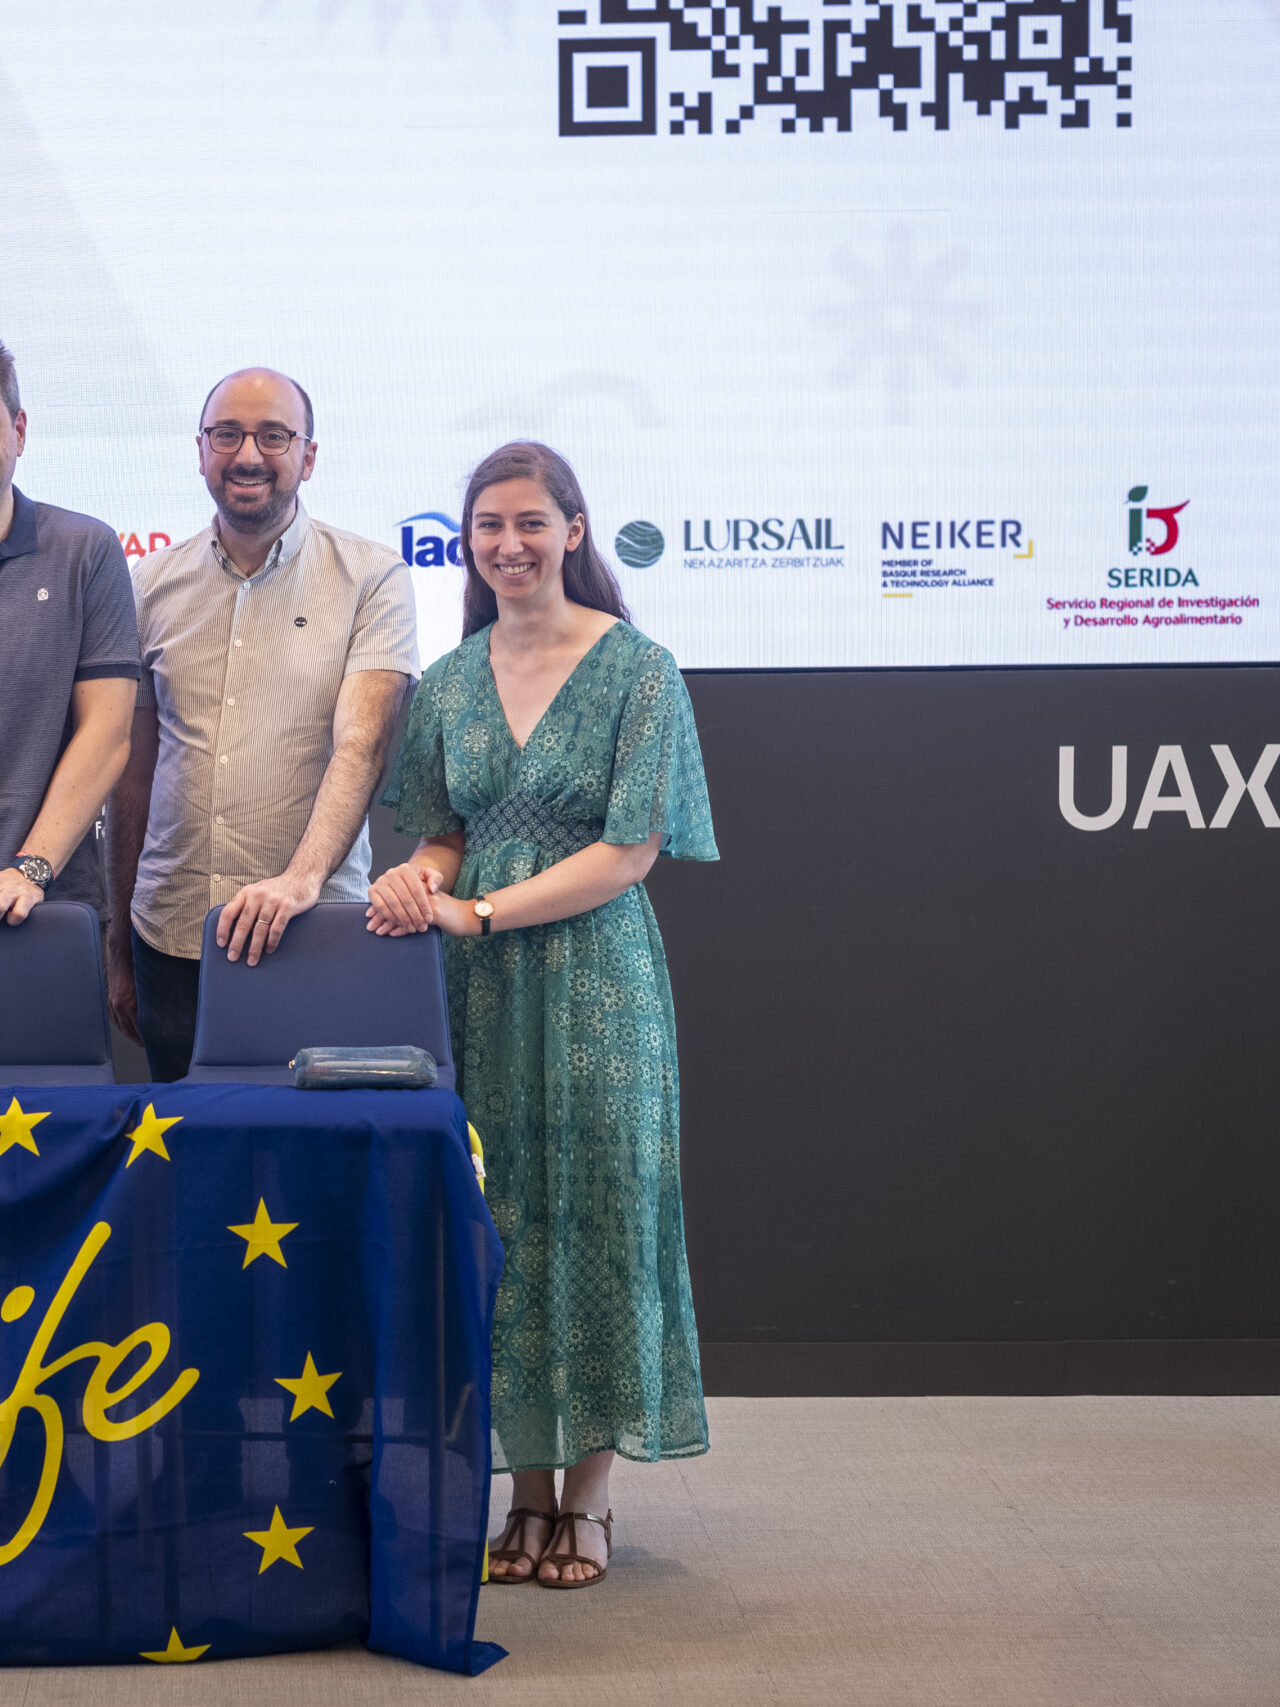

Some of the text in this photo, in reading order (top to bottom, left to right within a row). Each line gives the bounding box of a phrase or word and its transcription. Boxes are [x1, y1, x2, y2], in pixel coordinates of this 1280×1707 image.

[683, 518, 845, 551] LURSAIL
[881, 520, 1022, 550] NEIKER
[684, 557, 844, 569] NEKAZARITZA ZERBITZUAK
[920, 559, 933, 567] OF
[882, 569, 966, 578] BASQUE RESEARCH
[1107, 567, 1200, 589] SERIDA
[882, 578, 994, 588] & TECHNOLOGY ALLIANCE
[1046, 594, 1260, 612] Servicio Regional de Investigación
[1063, 613, 1242, 629] y Desarrollo Agroalimentario
[1059, 744, 1280, 832] UAX
